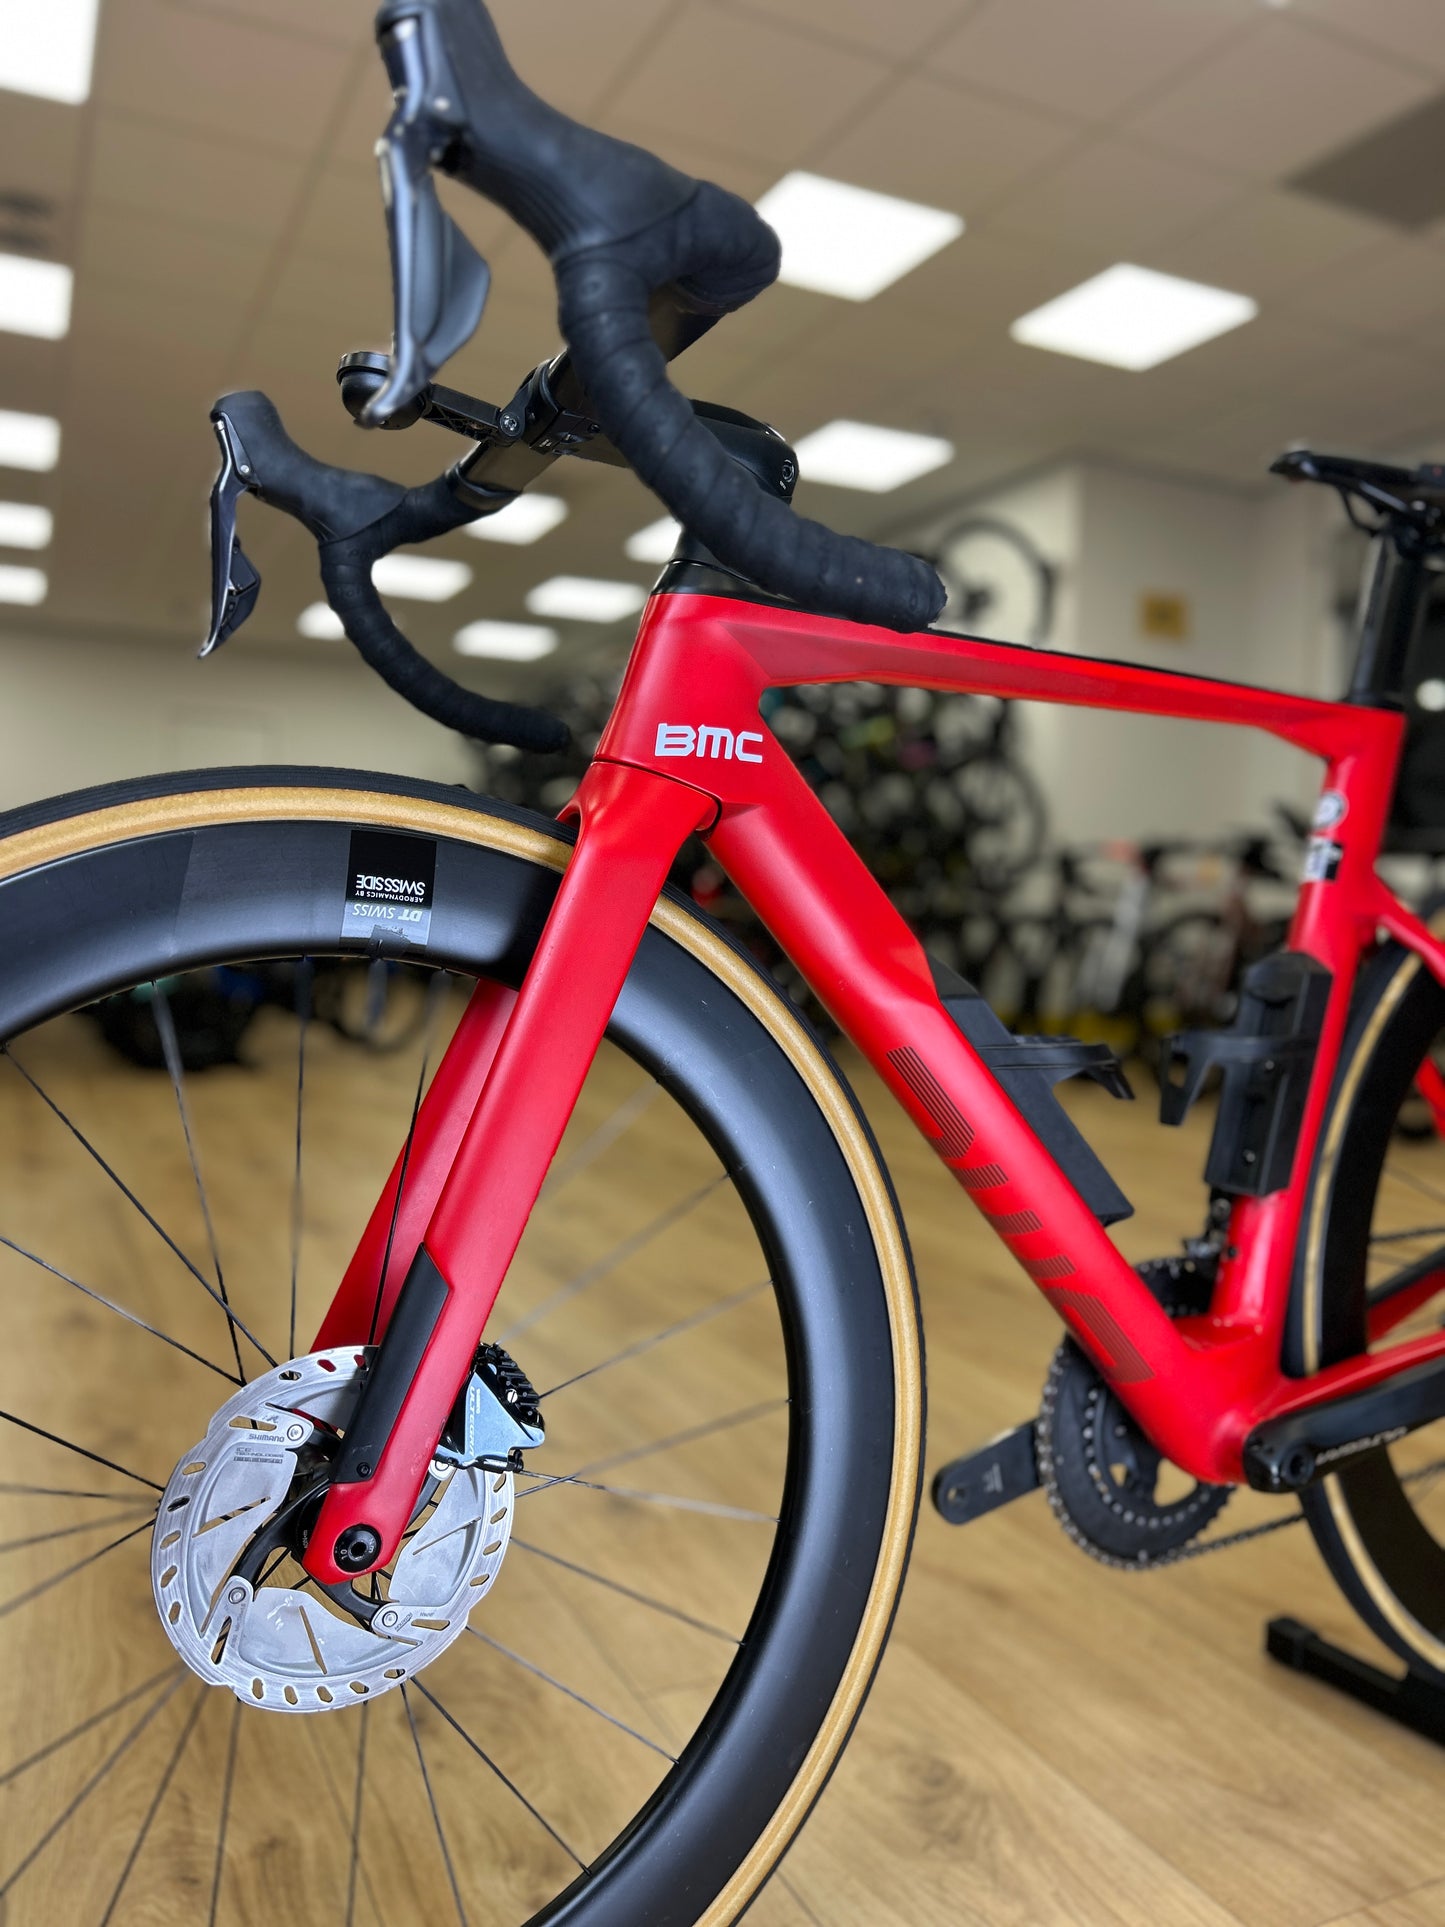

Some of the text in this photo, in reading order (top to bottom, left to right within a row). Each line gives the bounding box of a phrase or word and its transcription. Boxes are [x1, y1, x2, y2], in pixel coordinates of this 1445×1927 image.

[654, 722, 764, 764] BMC
[355, 889, 424, 903] AERODYNAMICS BY
[352, 903, 423, 922] DT SWISS
[248, 1433, 285, 1443] SHIMANO
